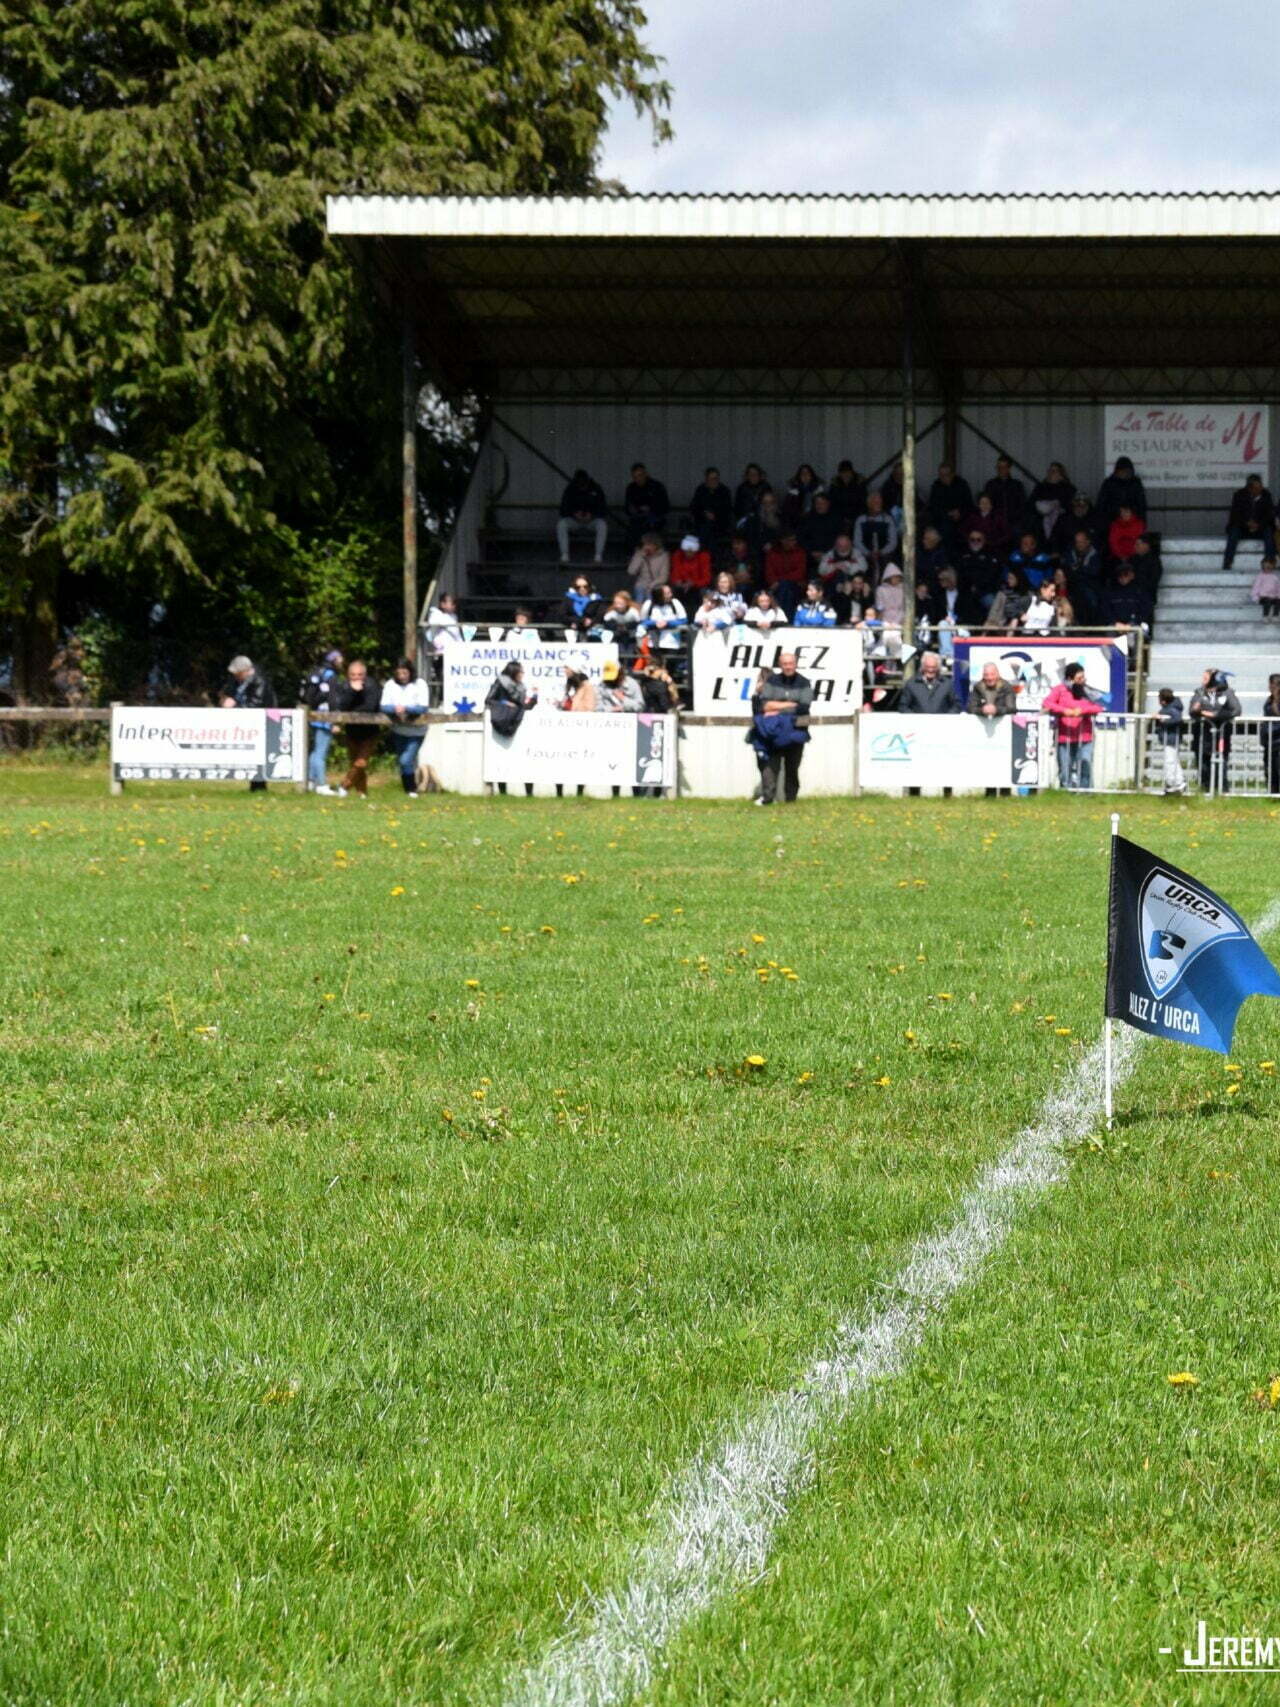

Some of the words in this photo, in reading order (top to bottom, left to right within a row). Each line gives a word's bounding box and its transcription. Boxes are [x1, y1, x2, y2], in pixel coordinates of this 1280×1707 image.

[1114, 411, 1141, 432] La
[1146, 411, 1189, 432] Table
[1195, 414, 1216, 432] de
[1222, 411, 1263, 462] M
[1112, 439, 1216, 452] RESTAURANT
[1165, 885, 1221, 920] URCA
[1164, 1005, 1200, 1035] URCA
